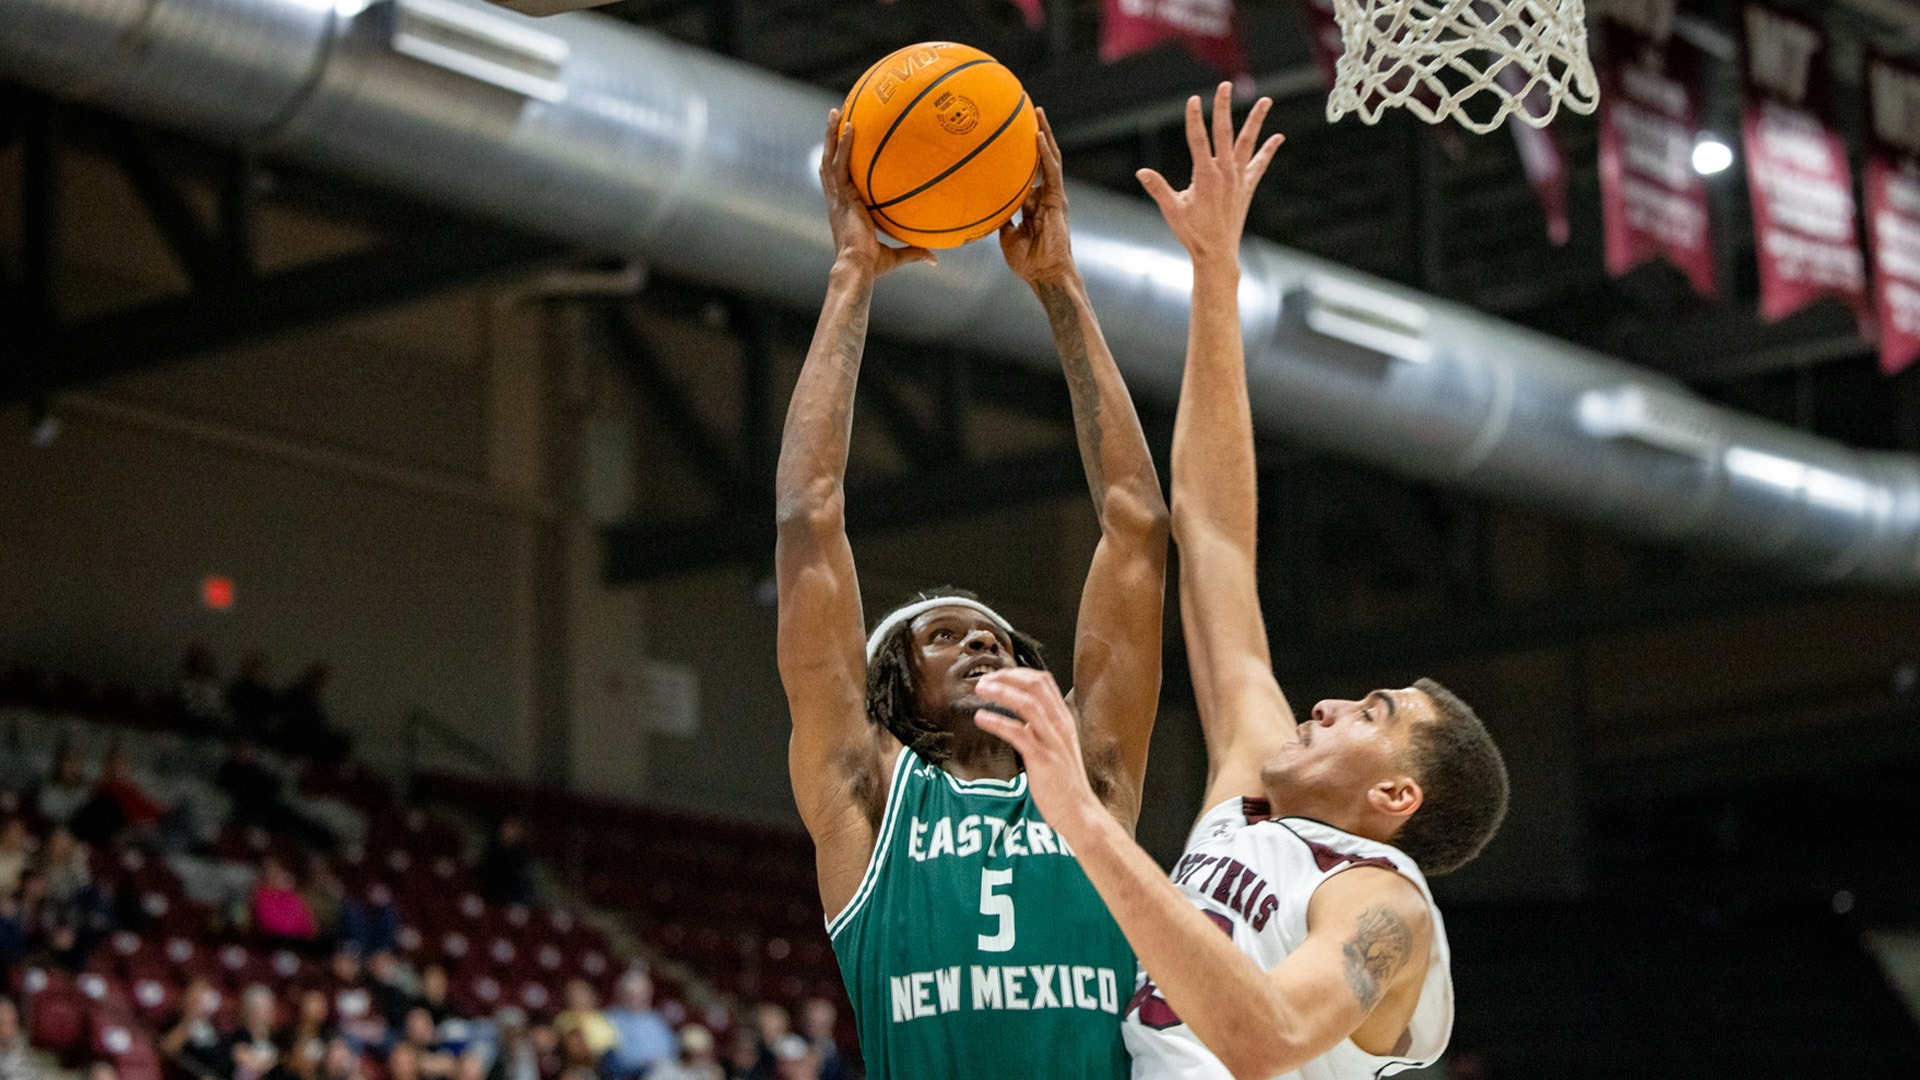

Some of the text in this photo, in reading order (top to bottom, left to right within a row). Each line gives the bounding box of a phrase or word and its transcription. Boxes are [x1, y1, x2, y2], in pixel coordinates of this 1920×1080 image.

[977, 866, 1016, 952] 5
[890, 965, 962, 1023] NEW
[970, 964, 1119, 1015] MEXICO
